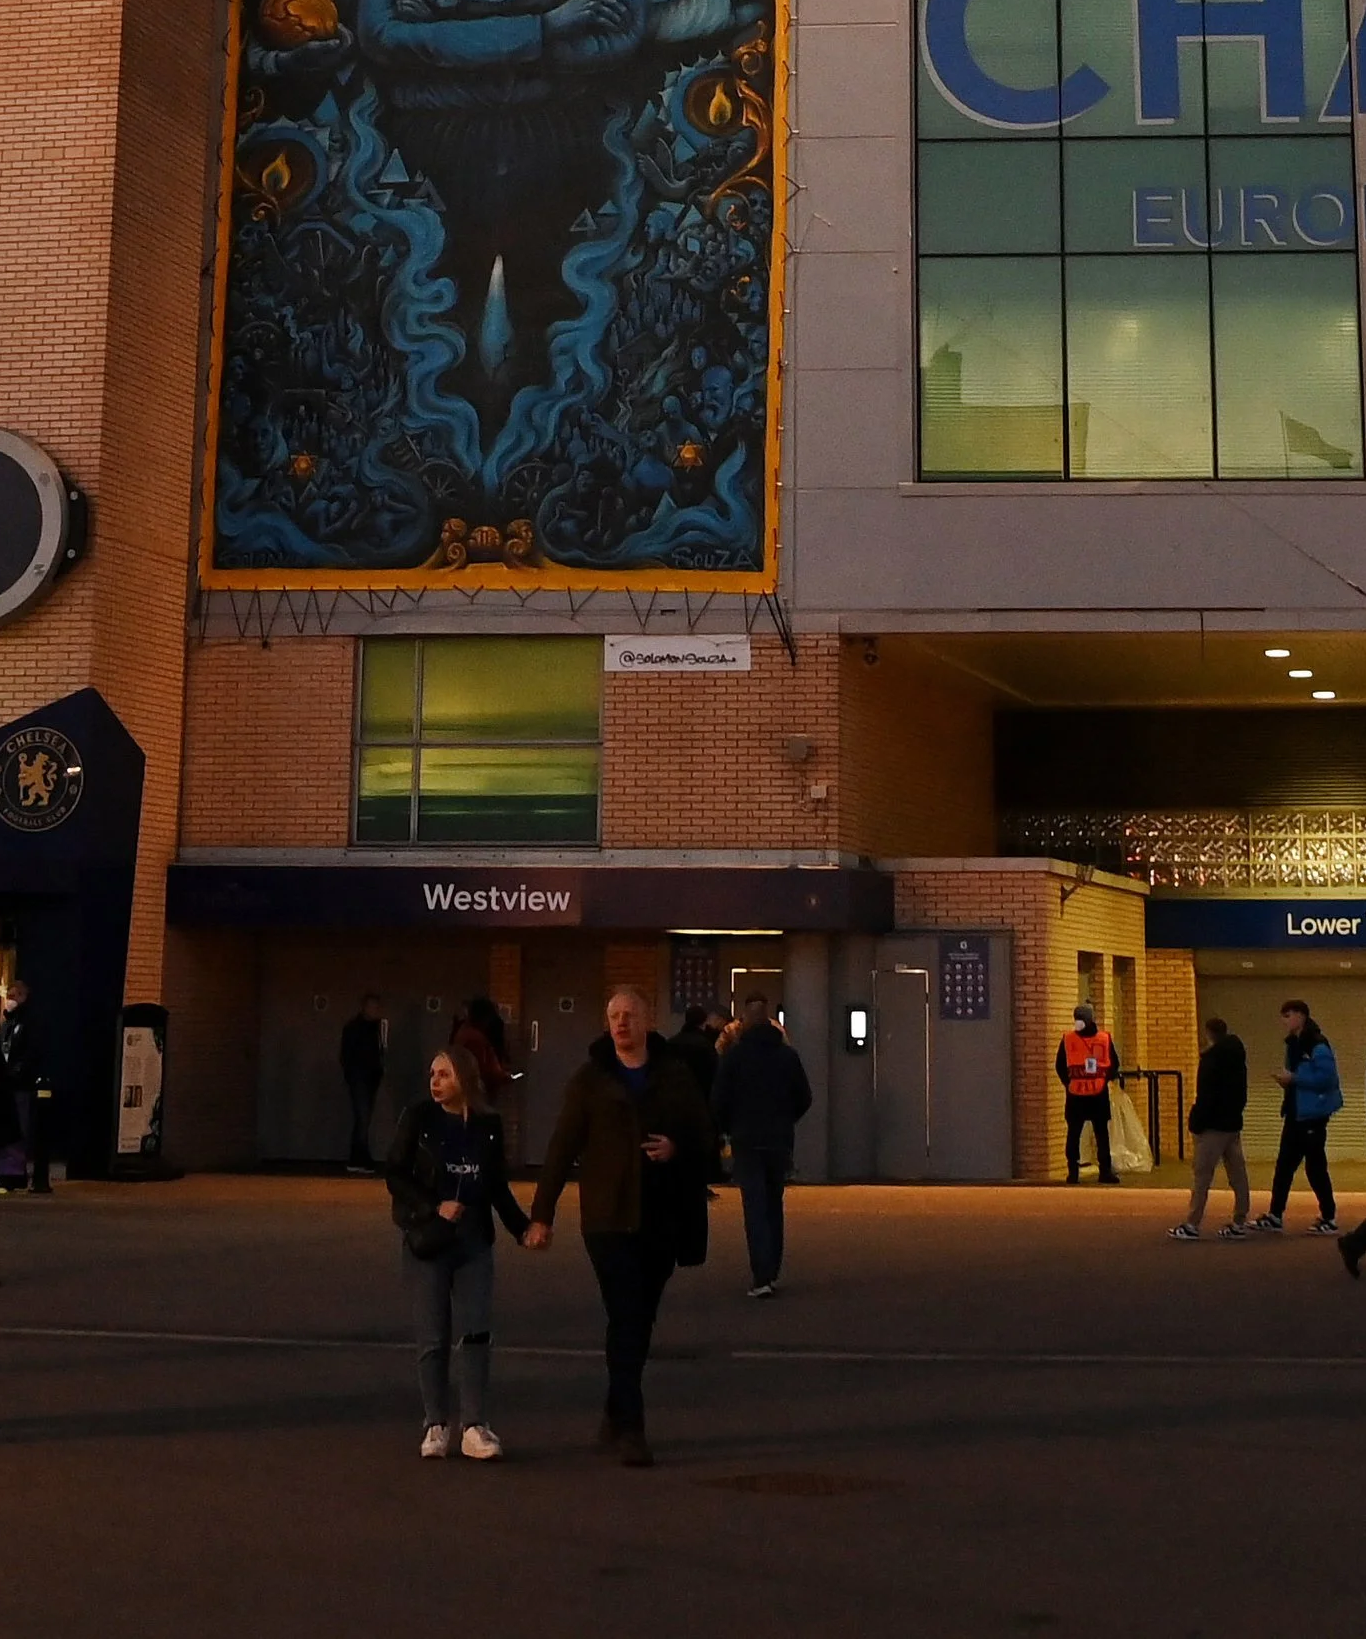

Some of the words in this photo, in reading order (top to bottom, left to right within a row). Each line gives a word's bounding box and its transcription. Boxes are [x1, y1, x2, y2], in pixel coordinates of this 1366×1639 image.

[6, 731, 67, 755] CHELSEA
[423, 883, 571, 911] Westview
[1287, 913, 1361, 935] Lower
